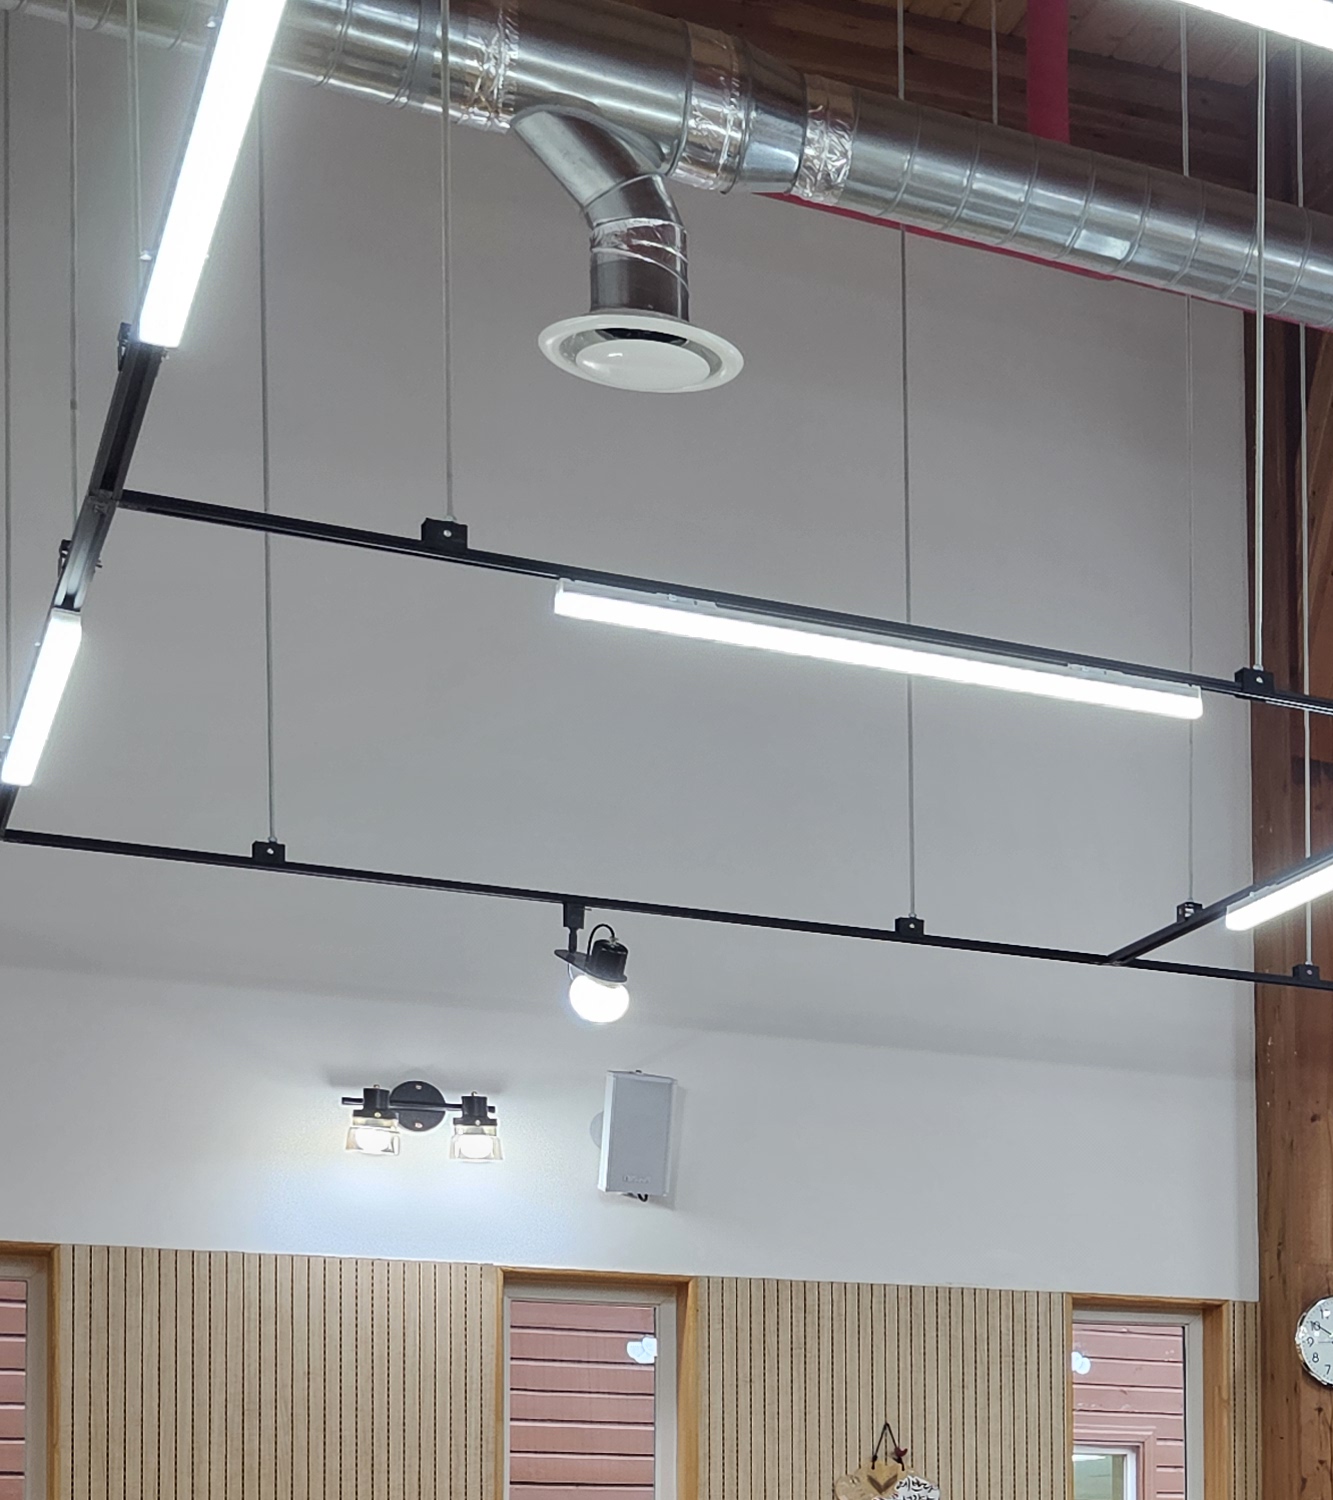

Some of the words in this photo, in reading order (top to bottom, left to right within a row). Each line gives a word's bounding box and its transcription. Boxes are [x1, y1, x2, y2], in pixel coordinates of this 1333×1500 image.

[1306, 1336, 1314, 1347] 9
[1311, 1352, 1319, 1363] 8
[1324, 1364, 1331, 1375] 7
